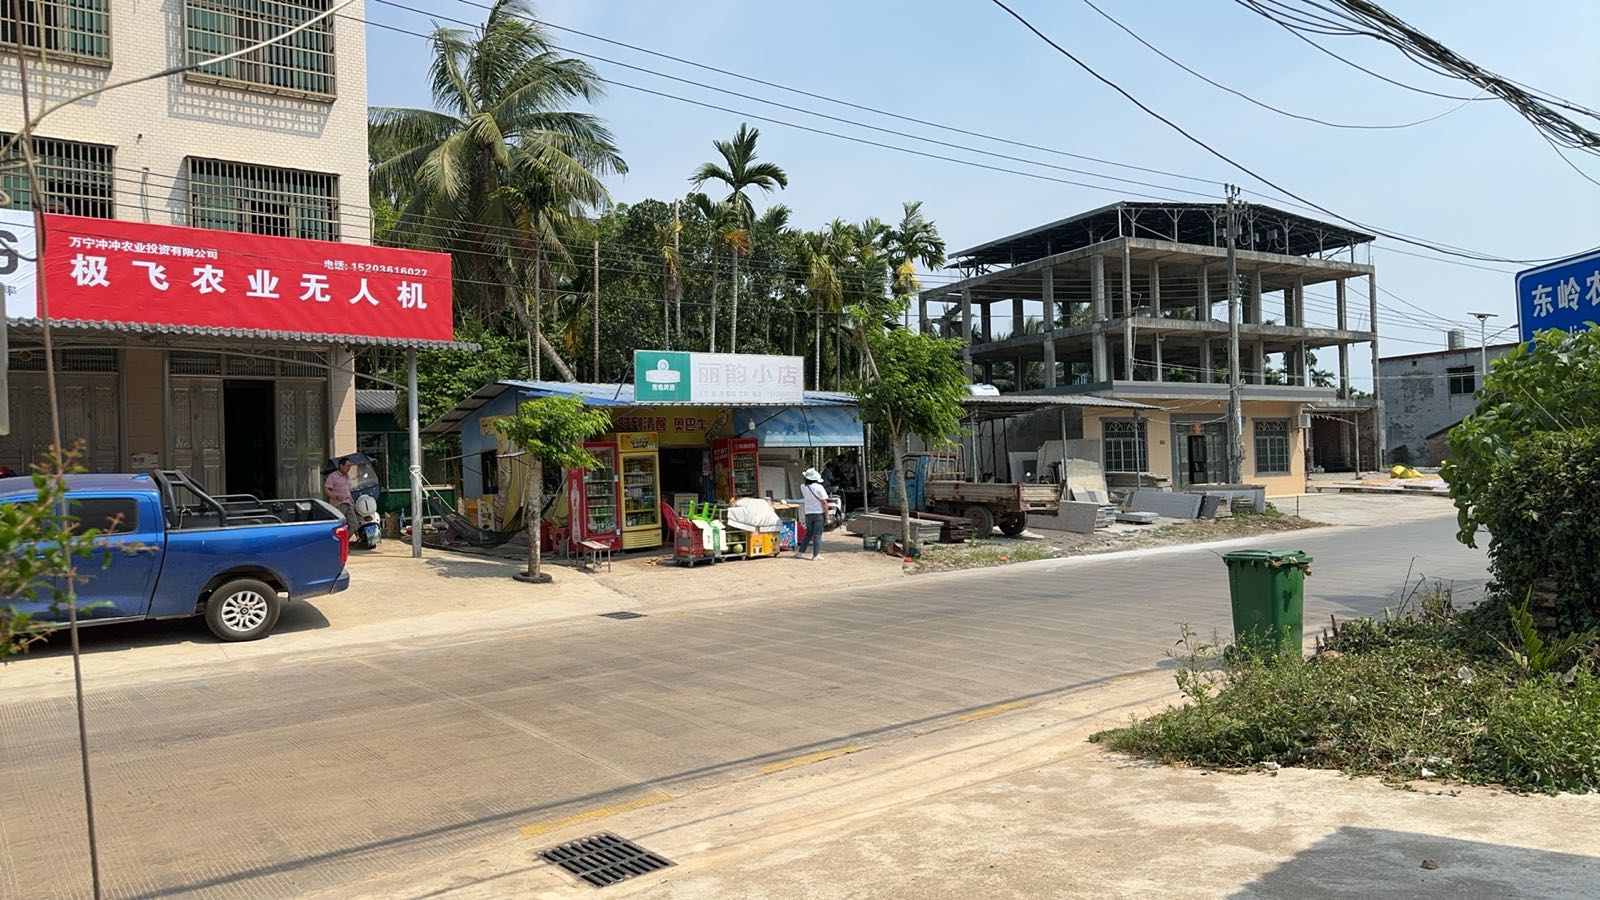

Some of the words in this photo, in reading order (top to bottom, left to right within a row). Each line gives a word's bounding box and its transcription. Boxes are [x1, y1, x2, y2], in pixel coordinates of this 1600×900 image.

[69, 236, 218, 260] 万宁冲冲农业投资有限公司
[70, 253, 428, 309] 极飞农业无人机
[351, 262, 428, 277] 15203616027
[1531, 270, 1600, 318] 东岭农
[697, 362, 798, 385] 丽韵小店
